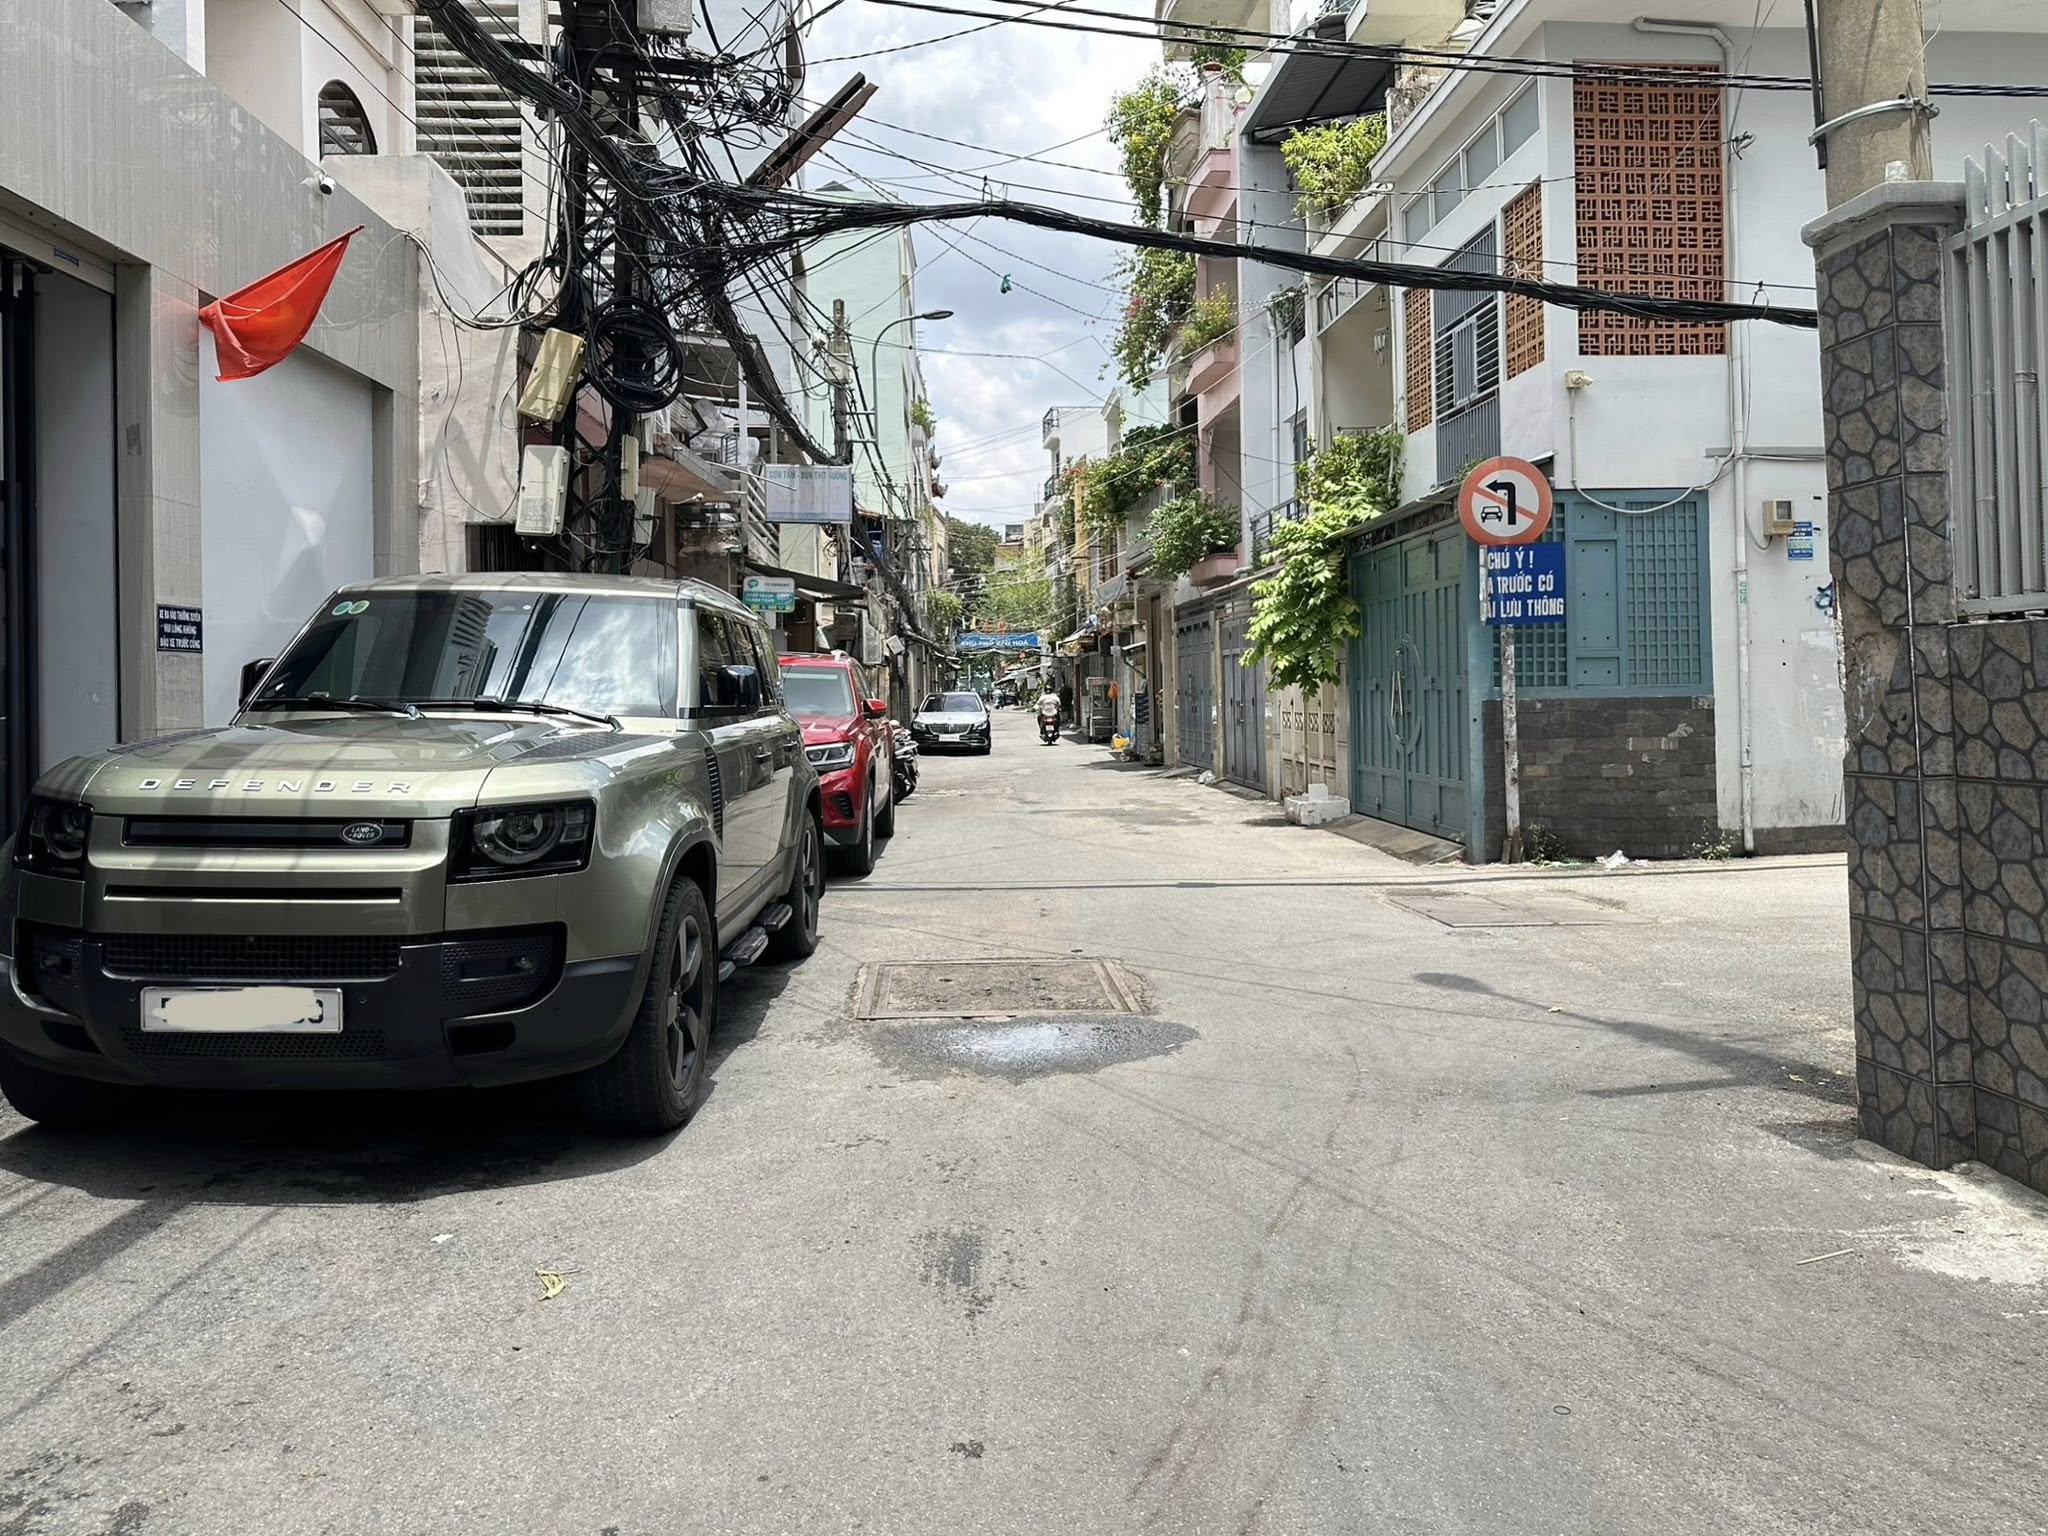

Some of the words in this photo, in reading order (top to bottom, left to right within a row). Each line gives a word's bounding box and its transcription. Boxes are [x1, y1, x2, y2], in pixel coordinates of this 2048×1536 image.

[1487, 547, 1510, 570] CHÚ
[1515, 546, 1525, 569] Ý
[1497, 570, 1532, 594] TRƯỚC
[1538, 570, 1554, 592] CÓ
[1500, 597, 1522, 618] LƯU
[1527, 595, 1564, 617] THÔNG
[138, 779, 412, 793] DEFENDER
